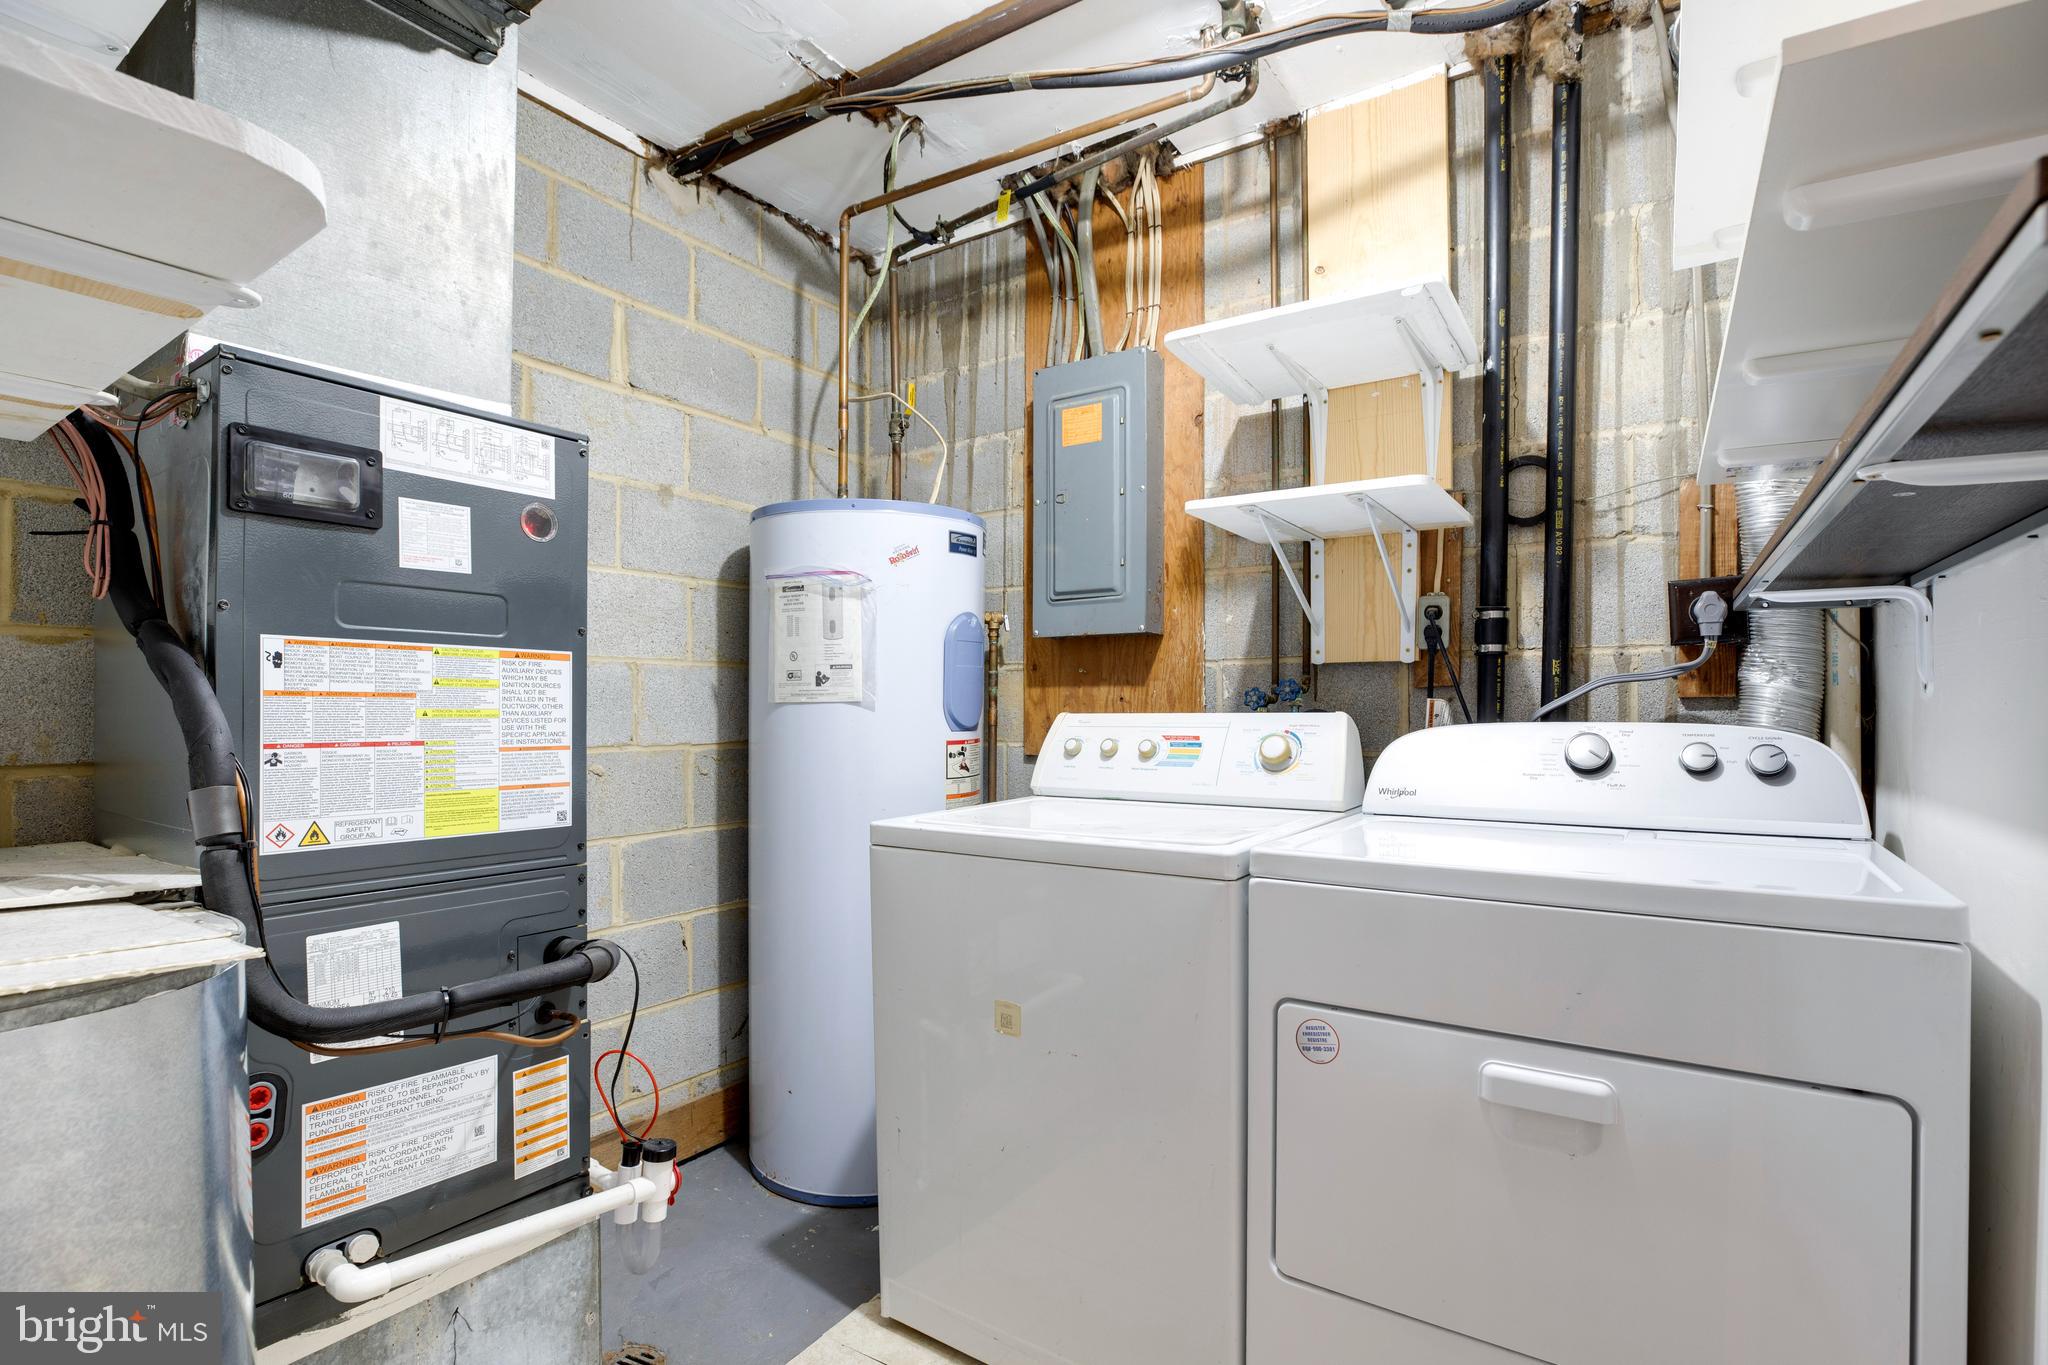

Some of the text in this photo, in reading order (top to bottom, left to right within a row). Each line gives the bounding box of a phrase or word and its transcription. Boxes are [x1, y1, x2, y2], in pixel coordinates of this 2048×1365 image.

[501, 659, 517, 667] RISK
[520, 652, 551, 660] WARNING
[1378, 787, 1417, 799] Whirlpool
[335, 818, 381, 827] REFRIGERANT
[308, 1100, 369, 1122] REFRIGERANT
[398, 1090, 408, 1098] TO
[421, 1076, 459, 1091] REPAIRED
[459, 1071, 479, 1081] ONLY
[480, 1068, 490, 1076] BY
[309, 1114, 347, 1130] TRAINED
[348, 1106, 384, 1120] SERVICE
[436, 1088, 448, 1096] DO
[448, 1082, 464, 1092] NOT
[320, 1095, 361, 1110] WARNING
[367, 1088, 386, 1098] RISK
[388, 1085, 399, 1093] OF
[421, 1067, 466, 1084] FLAMMABLE
[309, 1121, 357, 1138] PUNCTURE
[358, 1105, 410, 1126] REFRIGERANT
[309, 1135, 453, 1185] OFPROPERLY IN ACCORDANCE WITH
[320, 1156, 361, 1173] WARNING
[368, 1149, 387, 1159] RISK
[388, 1144, 400, 1153] OF
[422, 1127, 455, 1142] DISPOSE
[309, 1177, 350, 1193] FEDERAL
[350, 1171, 364, 1180] OR
[365, 1164, 391, 1176] LOCAL
[309, 1181, 361, 1201] FLAMMABLE
[362, 1162, 418, 1184] REFRIGERANT
